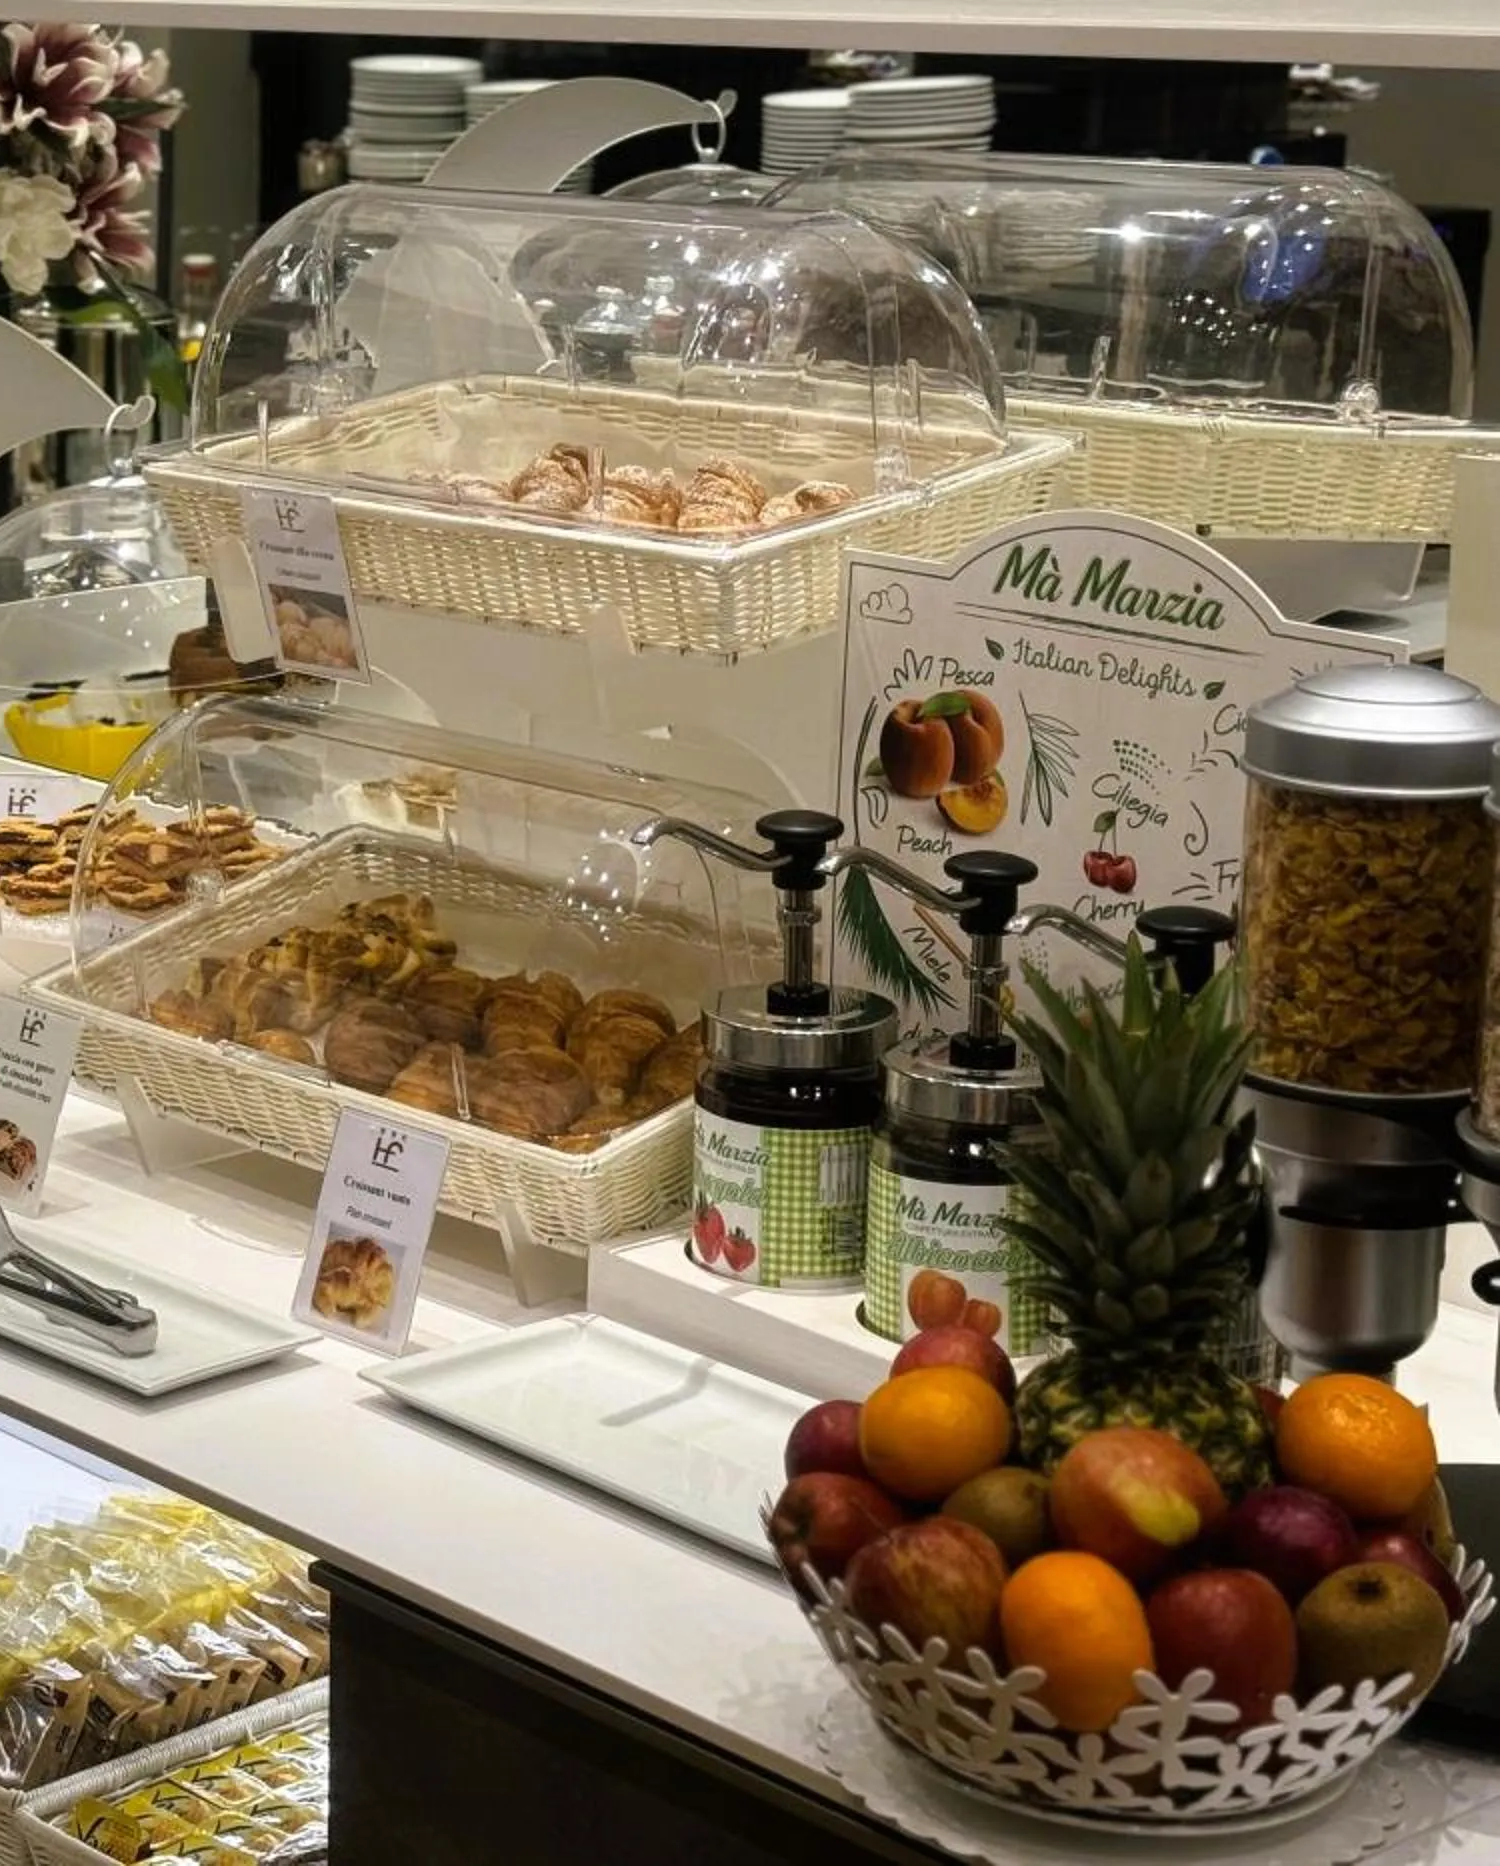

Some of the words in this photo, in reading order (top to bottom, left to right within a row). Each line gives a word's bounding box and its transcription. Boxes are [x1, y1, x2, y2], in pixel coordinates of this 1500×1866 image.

[993, 543, 1064, 602] Mà
[1070, 556, 1226, 631] Marzia
[938, 656, 996, 688] Pesca
[1011, 637, 1094, 679] Italian
[1098, 652, 1198, 700] Delights
[1091, 773, 1170, 829] Ciliegia
[895, 825, 954, 854] Peach
[900, 926, 952, 984] Miele
[707, 1131, 771, 1166] Marzia
[895, 1194, 926, 1221] Mà
